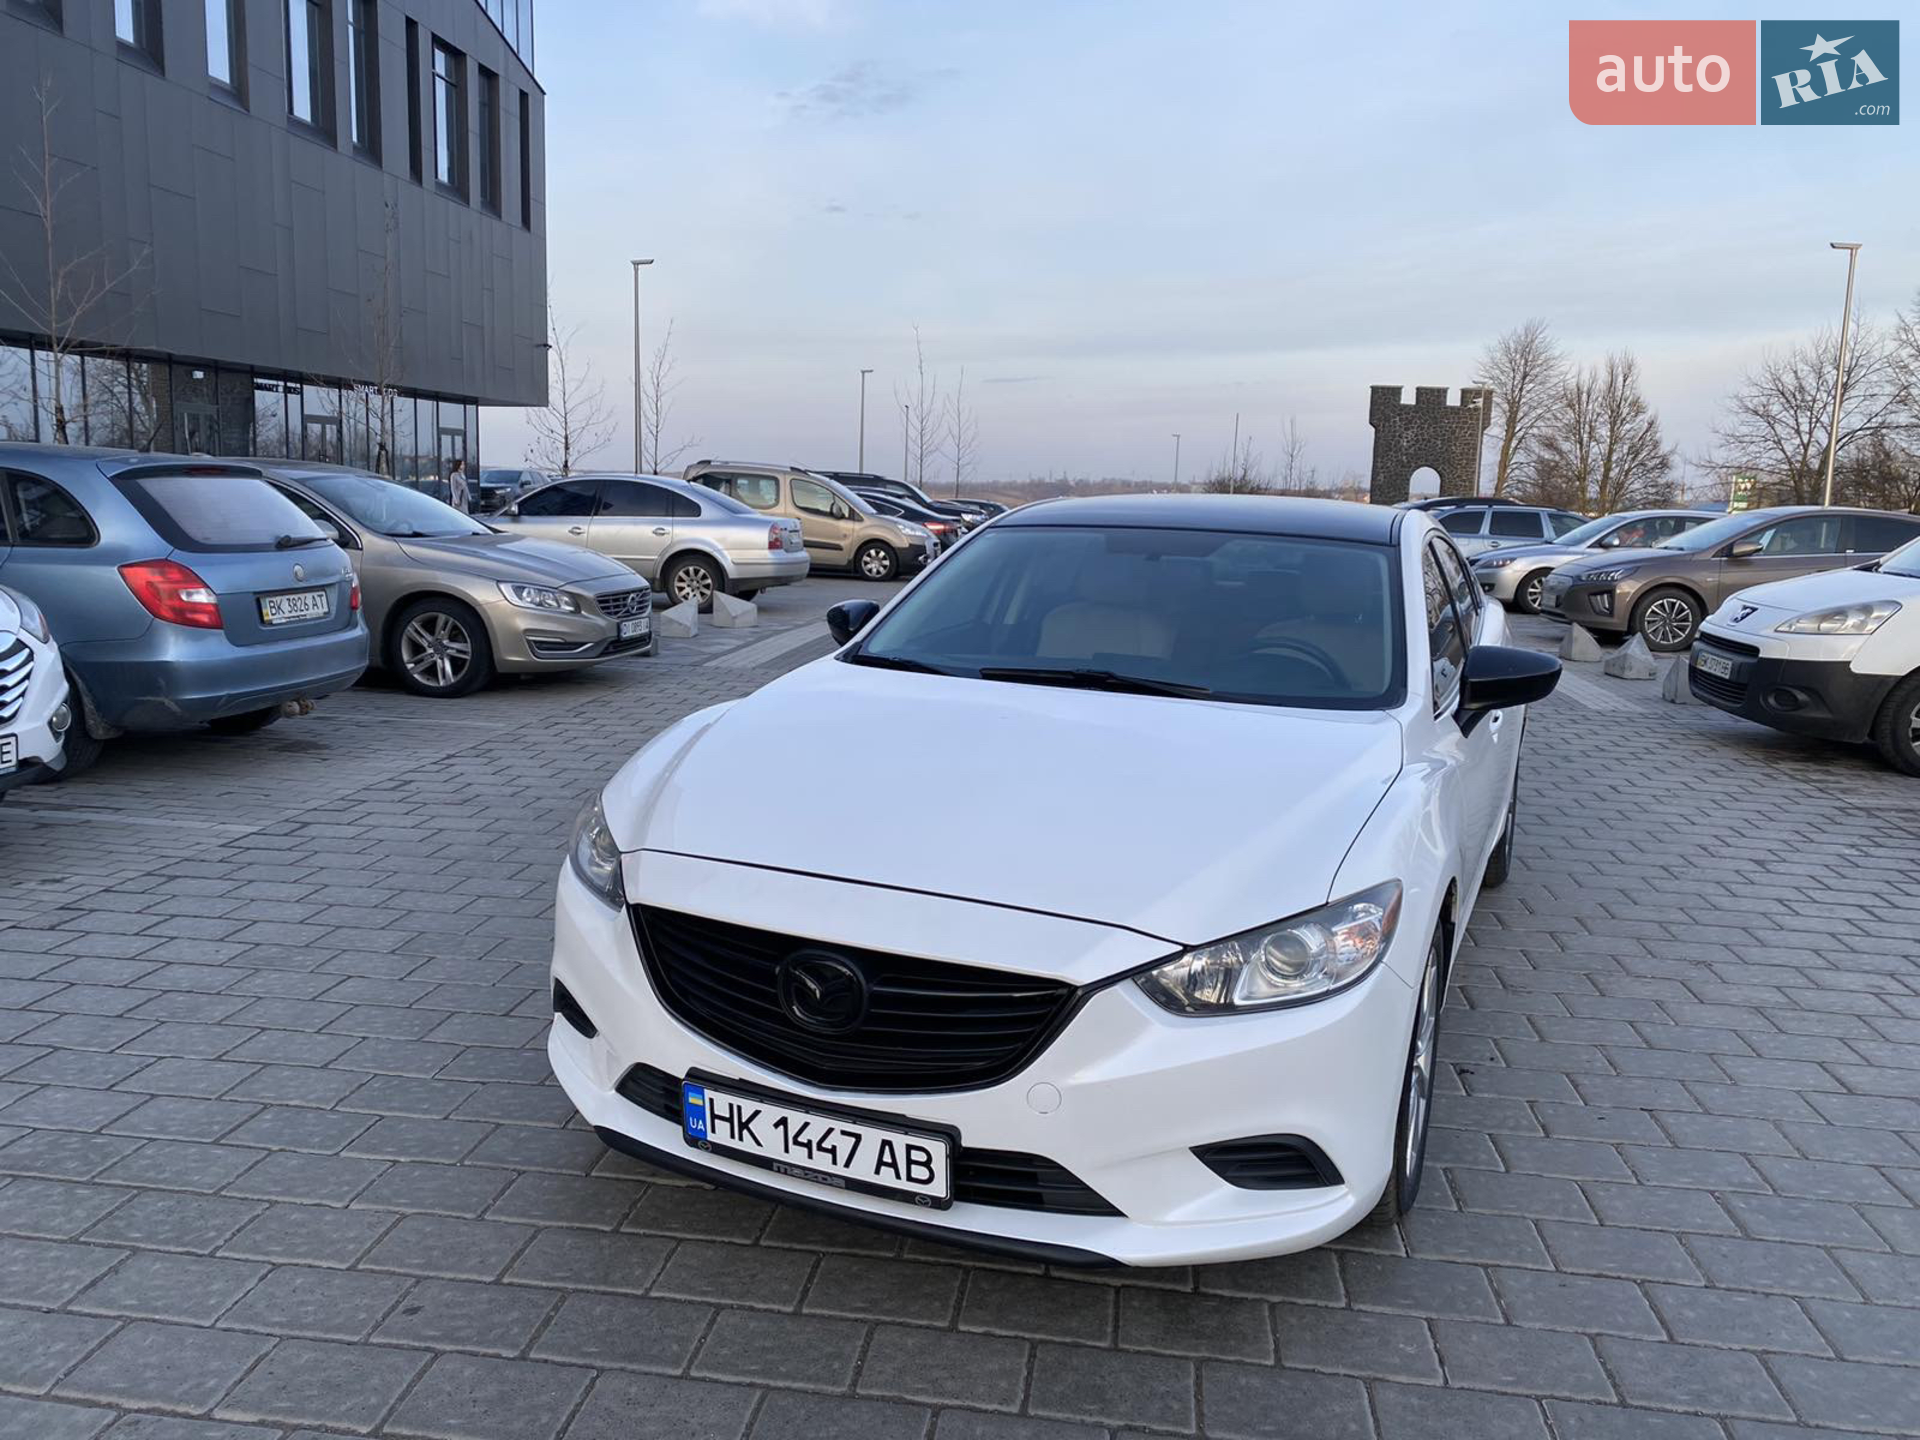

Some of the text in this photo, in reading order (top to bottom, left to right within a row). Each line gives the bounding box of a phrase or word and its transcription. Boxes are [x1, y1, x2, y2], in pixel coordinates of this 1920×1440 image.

[268, 593, 325, 616] BK 3826 AT
[689, 1116, 705, 1132] UA
[708, 1097, 935, 1185] HK 1447 AB
